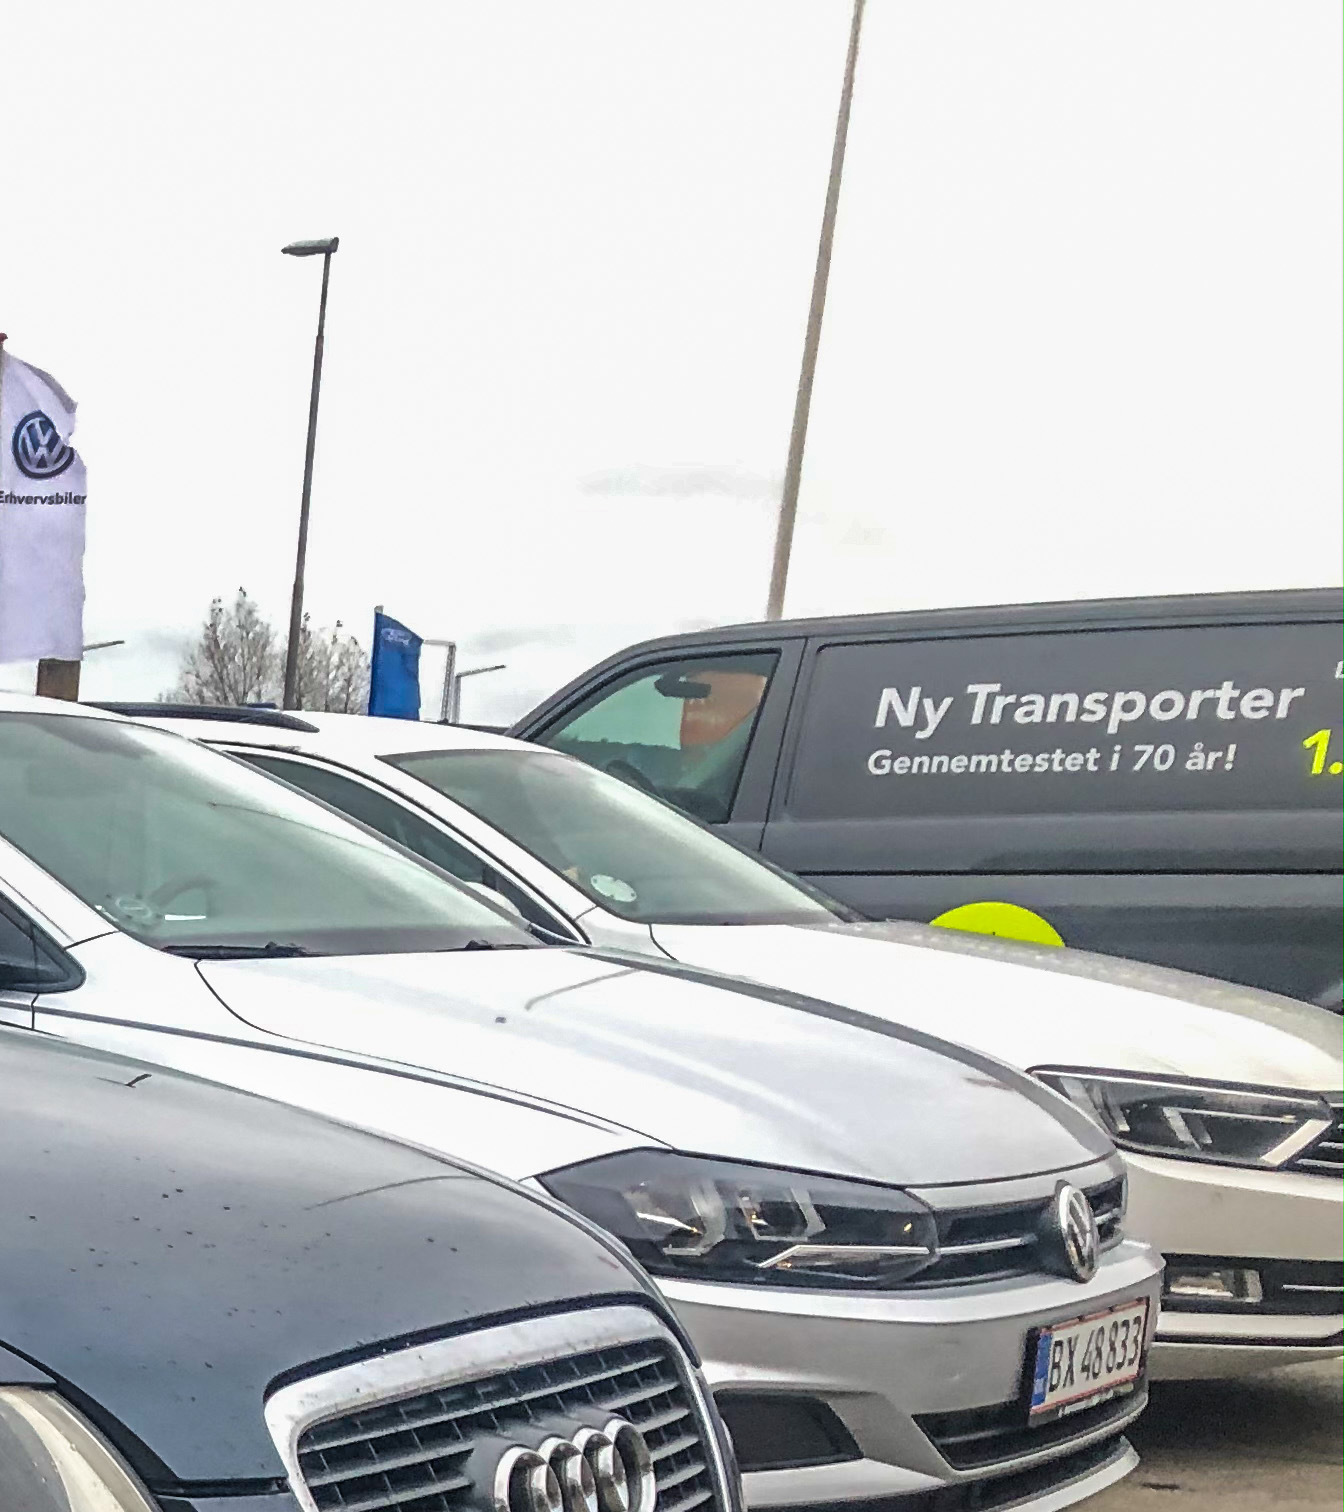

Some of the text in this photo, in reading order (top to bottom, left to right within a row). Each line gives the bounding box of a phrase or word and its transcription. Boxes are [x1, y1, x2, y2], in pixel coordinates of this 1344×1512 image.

[874, 680, 1305, 740] Ny Transporter
[867, 741, 1238, 776] Gennemtestet i 70 år!
